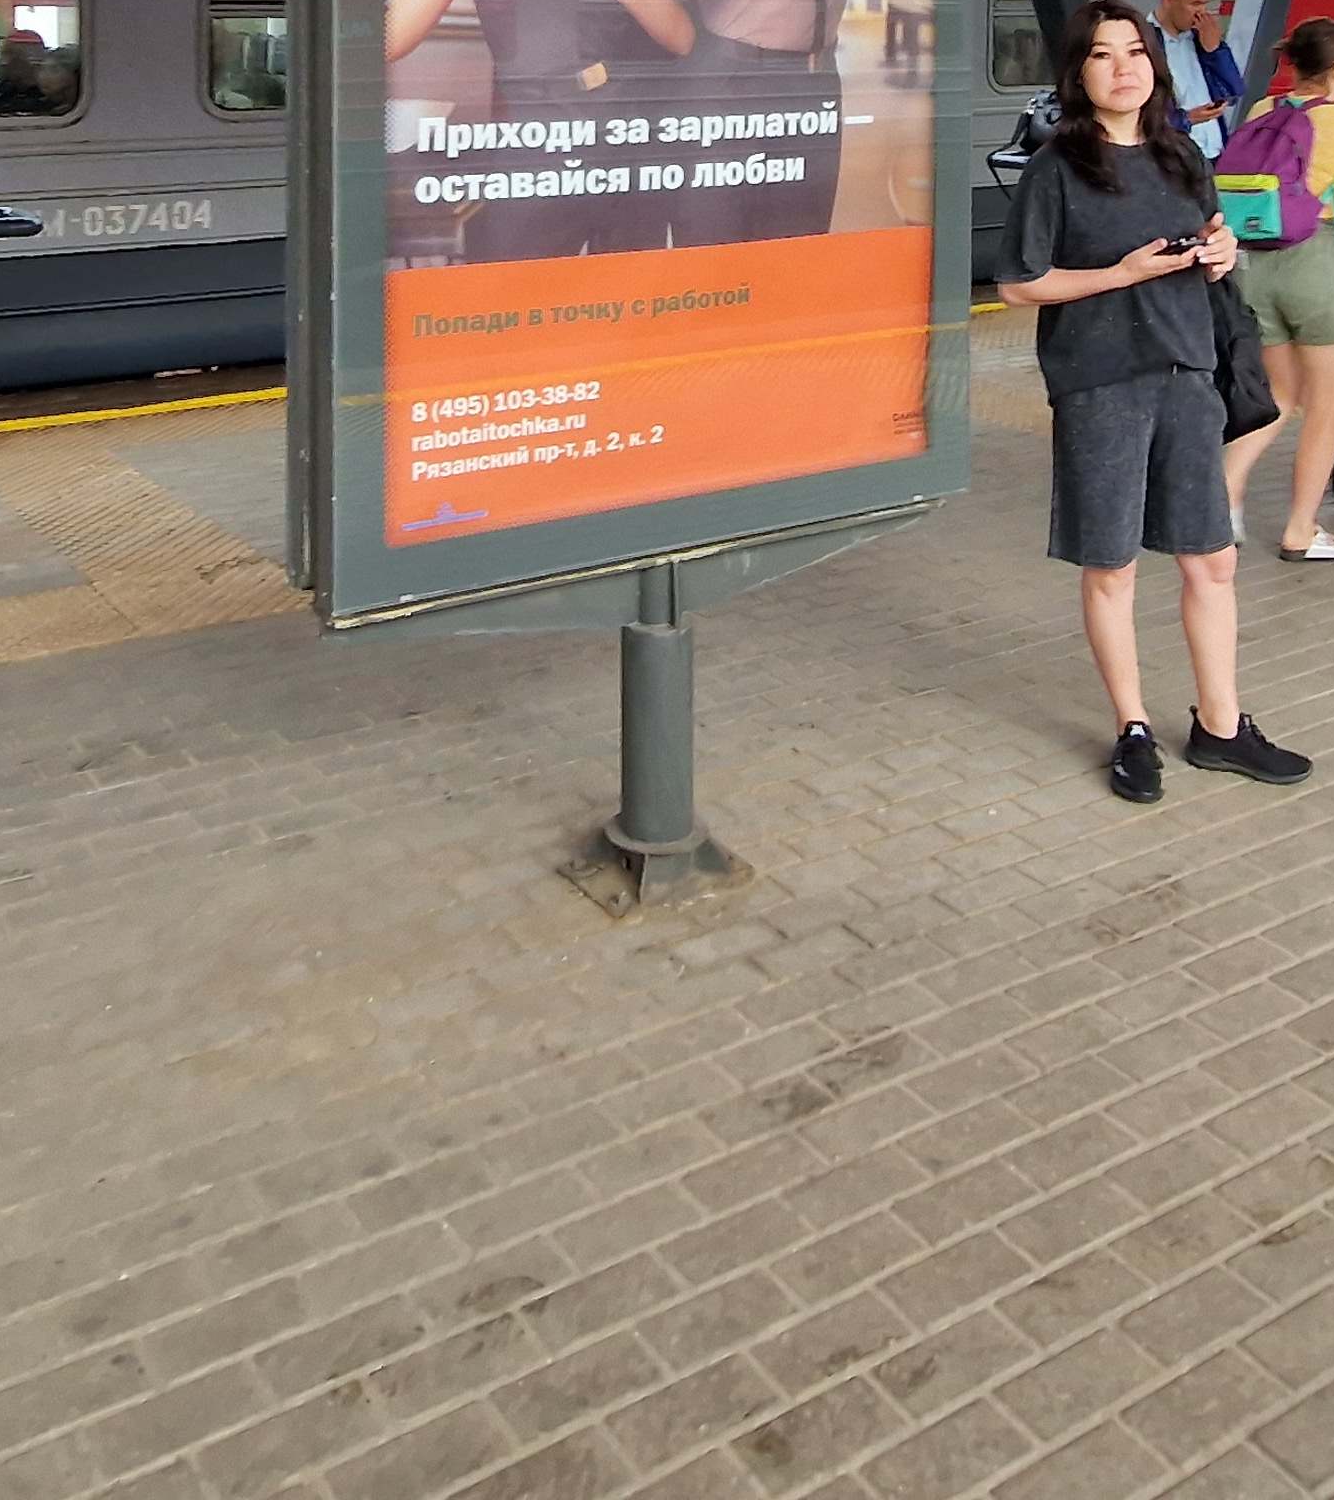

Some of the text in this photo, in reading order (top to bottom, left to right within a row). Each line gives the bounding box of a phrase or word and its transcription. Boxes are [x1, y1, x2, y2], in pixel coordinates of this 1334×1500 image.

[417, 116, 597, 160] Приходи
[604, 117, 651, 146] за
[657, 100, 839, 148] зарплатой
[414, 152, 805, 204] оставайся по любви
[412, 282, 751, 338] Попади в точку с работой
[411, 380, 602, 424] 8 (495) 103-38-82
[411, 413, 587, 452] rabotaitochka.ru
[411, 424, 666, 482] Рязанский пр-т, д. 2, к. 2
